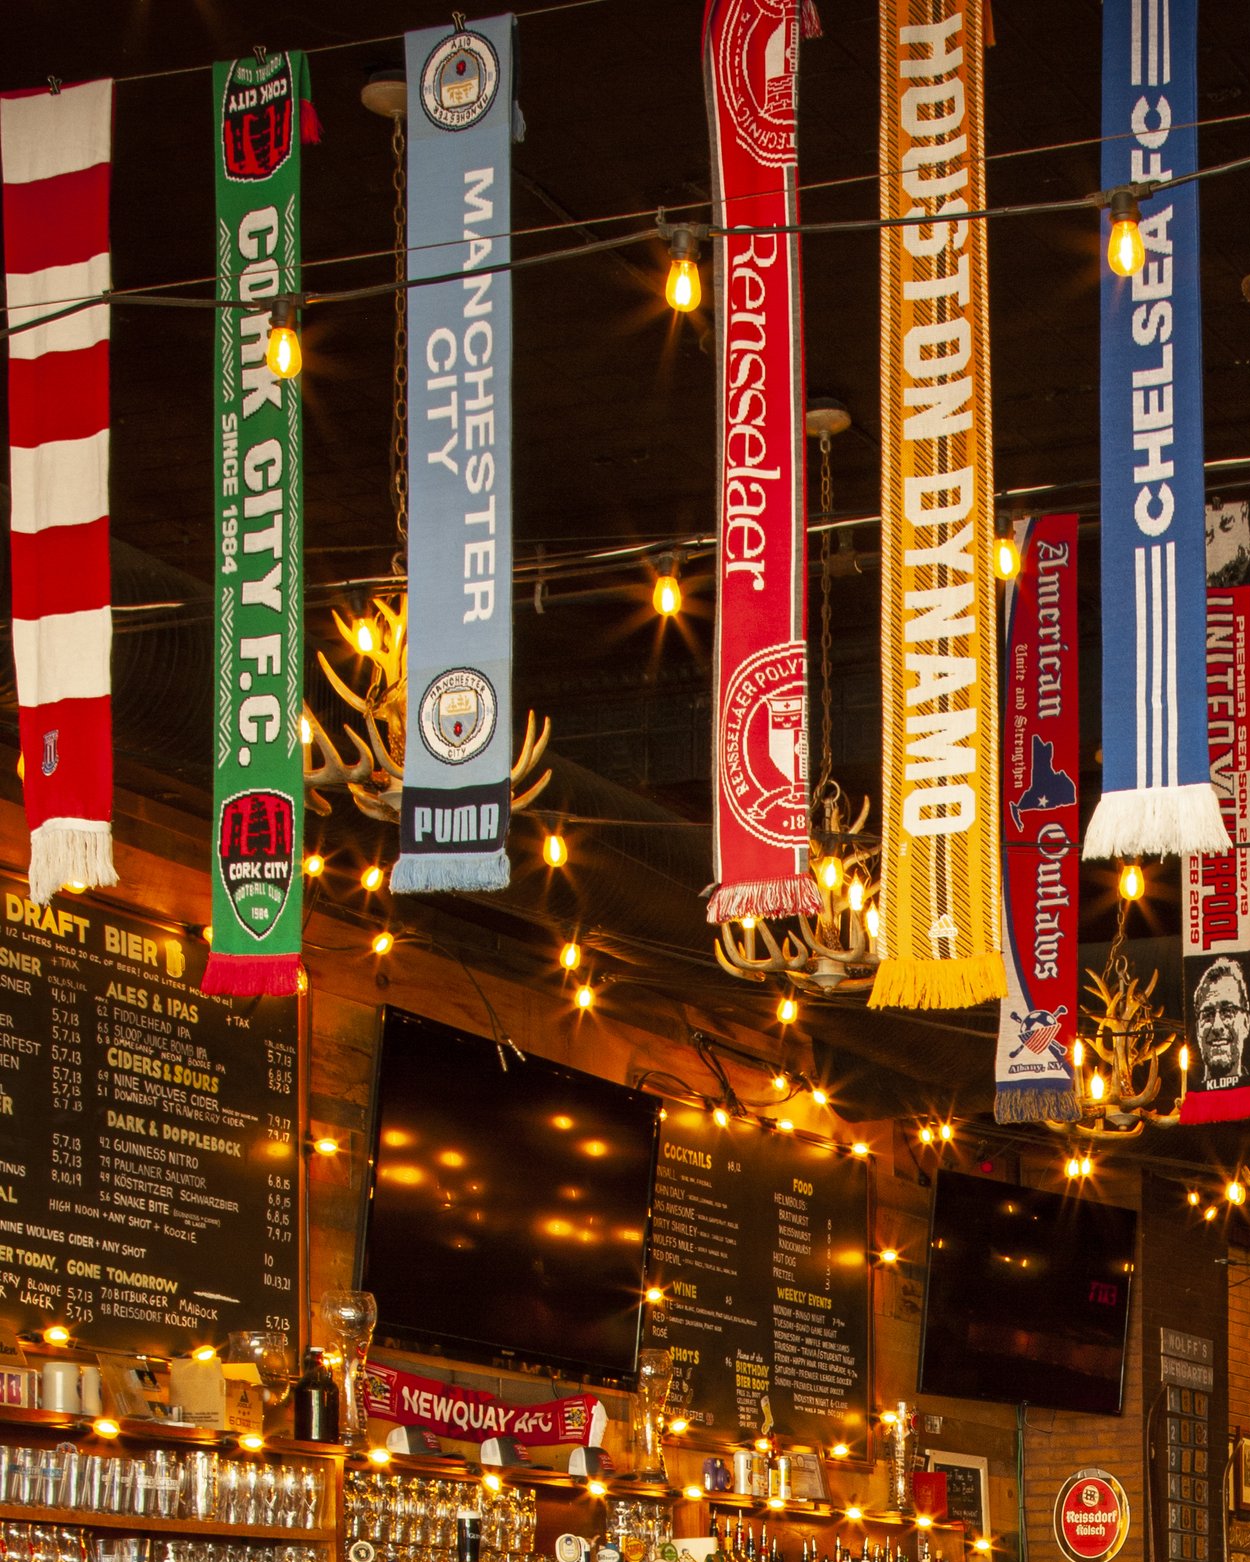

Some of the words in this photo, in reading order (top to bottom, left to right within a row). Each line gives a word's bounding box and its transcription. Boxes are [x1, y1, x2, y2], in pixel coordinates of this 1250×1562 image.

[450, 36, 472, 50] CITY
[229, 88, 257, 113] CITY
[260, 78, 287, 104] CORK
[432, 94, 490, 127] MANCHESTER
[1131, 95, 1173, 192] FC
[899, 12, 975, 441] HOUSTON
[238, 204, 282, 419] CORK
[1132, 204, 1176, 537] CHELSEA
[426, 327, 459, 477] CITY
[462, 166, 496, 624] MANCHESTER
[725, 222, 781, 592] Rensselaer
[222, 412, 239, 496] SINCE
[221, 504, 239, 574] 1984
[243, 438, 285, 612] CITY
[1034, 539, 1070, 721] American
[902, 465, 978, 837] DYNAMO
[1011, 643, 1029, 681] Unite
[1236, 615, 1247, 718] PREMIER
[238, 636, 282, 768] F.C.
[428, 673, 487, 702] MANCHESTER
[1014, 687, 1028, 709] and
[446, 747, 468, 760] CITY
[726, 680, 758, 797] RENSSELAER
[1012, 714, 1029, 789] Strengthen
[1237, 725, 1248, 819] SEASON
[414, 803, 500, 844] PUMA
[229, 860, 261, 881] CORK
[263, 859, 290, 880] CITY
[250, 906, 270, 922] 1984
[1034, 821, 1071, 982] Outlaws
[1188, 889, 1200, 944] 2019
[6, 892, 90, 944] DRAFT
[104, 924, 158, 967] BIER
[22, 931, 52, 949] LITERS
[105, 980, 149, 1009] ALES
[152, 994, 163, 1014] &
[167, 997, 200, 1024] IPAS
[113, 1006, 173, 1036] FIDDLEHEAD
[177, 1025, 192, 1041] IPA
[233, 1015, 250, 1029] TAX
[114, 1025, 143, 1044] SLOOP
[143, 1033, 169, 1053] JUICE
[170, 1039, 195, 1058] BOMB
[107, 1046, 162, 1080] CIDERS
[162, 1063, 173, 1082] &
[173, 1065, 220, 1094] SOURS
[1007, 1062, 1044, 1075] Albany,
[1206, 1075, 1241, 1089] KLOPP
[113, 1073, 140, 1092] NINE
[144, 1077, 188, 1104] WOLVES
[190, 1092, 220, 1112] CIDER
[114, 1088, 158, 1109] DOWNEAST
[162, 1100, 221, 1126] STRAWBERRY
[221, 1113, 246, 1129] CIDER
[107, 1110, 146, 1137] DARK
[148, 1119, 159, 1138] &
[162, 1122, 242, 1158] DOPPLEBOCK
[113, 1137, 167, 1163] GUINNESS
[168, 1151, 200, 1171] NITRO
[663, 1141, 713, 1170] COCKTAILS
[113, 1158, 163, 1183] PAULANER
[164, 1168, 207, 1190] SALVATOR
[792, 1178, 814, 1197] FOOD
[113, 1170, 174, 1199] KÖSTRITZER
[179, 1190, 240, 1214] SCHWARZBIER
[113, 1191, 146, 1214] SNAKE
[148, 1199, 170, 1216] BITE
[49, 1199, 71, 1214] HIGH
[74, 1204, 100, 1219] NOON
[107, 1211, 126, 1228] ANY
[128, 1215, 152, 1232] SHOT
[0, 1219, 24, 1235] NINE
[26, 1223, 65, 1243] WOLVES
[68, 1232, 94, 1249] CIDER
[102, 1240, 121, 1254] ANY
[121, 1244, 147, 1259] SHOT
[16, 1248, 59, 1274] TODAY,
[67, 1259, 101, 1280] GONE
[105, 1266, 179, 1295] TOMORROW
[263, 1253, 274, 1268] 10
[20, 1290, 54, 1311] LAGER
[27, 1277, 62, 1297] BLONDE
[672, 1280, 698, 1300] WINE
[777, 1286, 807, 1305] WEEKLY
[808, 1290, 832, 1310] EVENTS
[112, 1303, 163, 1324] REISSDORF
[179, 1299, 219, 1321] MAIBOCK
[669, 1345, 700, 1366] SHOTS
[1167, 1334, 1208, 1356] WOLFF'S
[736, 1360, 770, 1379] BIRTHDAY
[736, 1373, 752, 1389] BIER
[752, 1377, 770, 1392] BOOT
[1162, 1361, 1213, 1388] BIERGARTEN
[401, 1385, 515, 1434] NEWQUAY
[514, 1411, 553, 1434] AFC
[1066, 1510, 1118, 1524] Reissdorf
[1076, 1524, 1106, 1537] Kölsch
